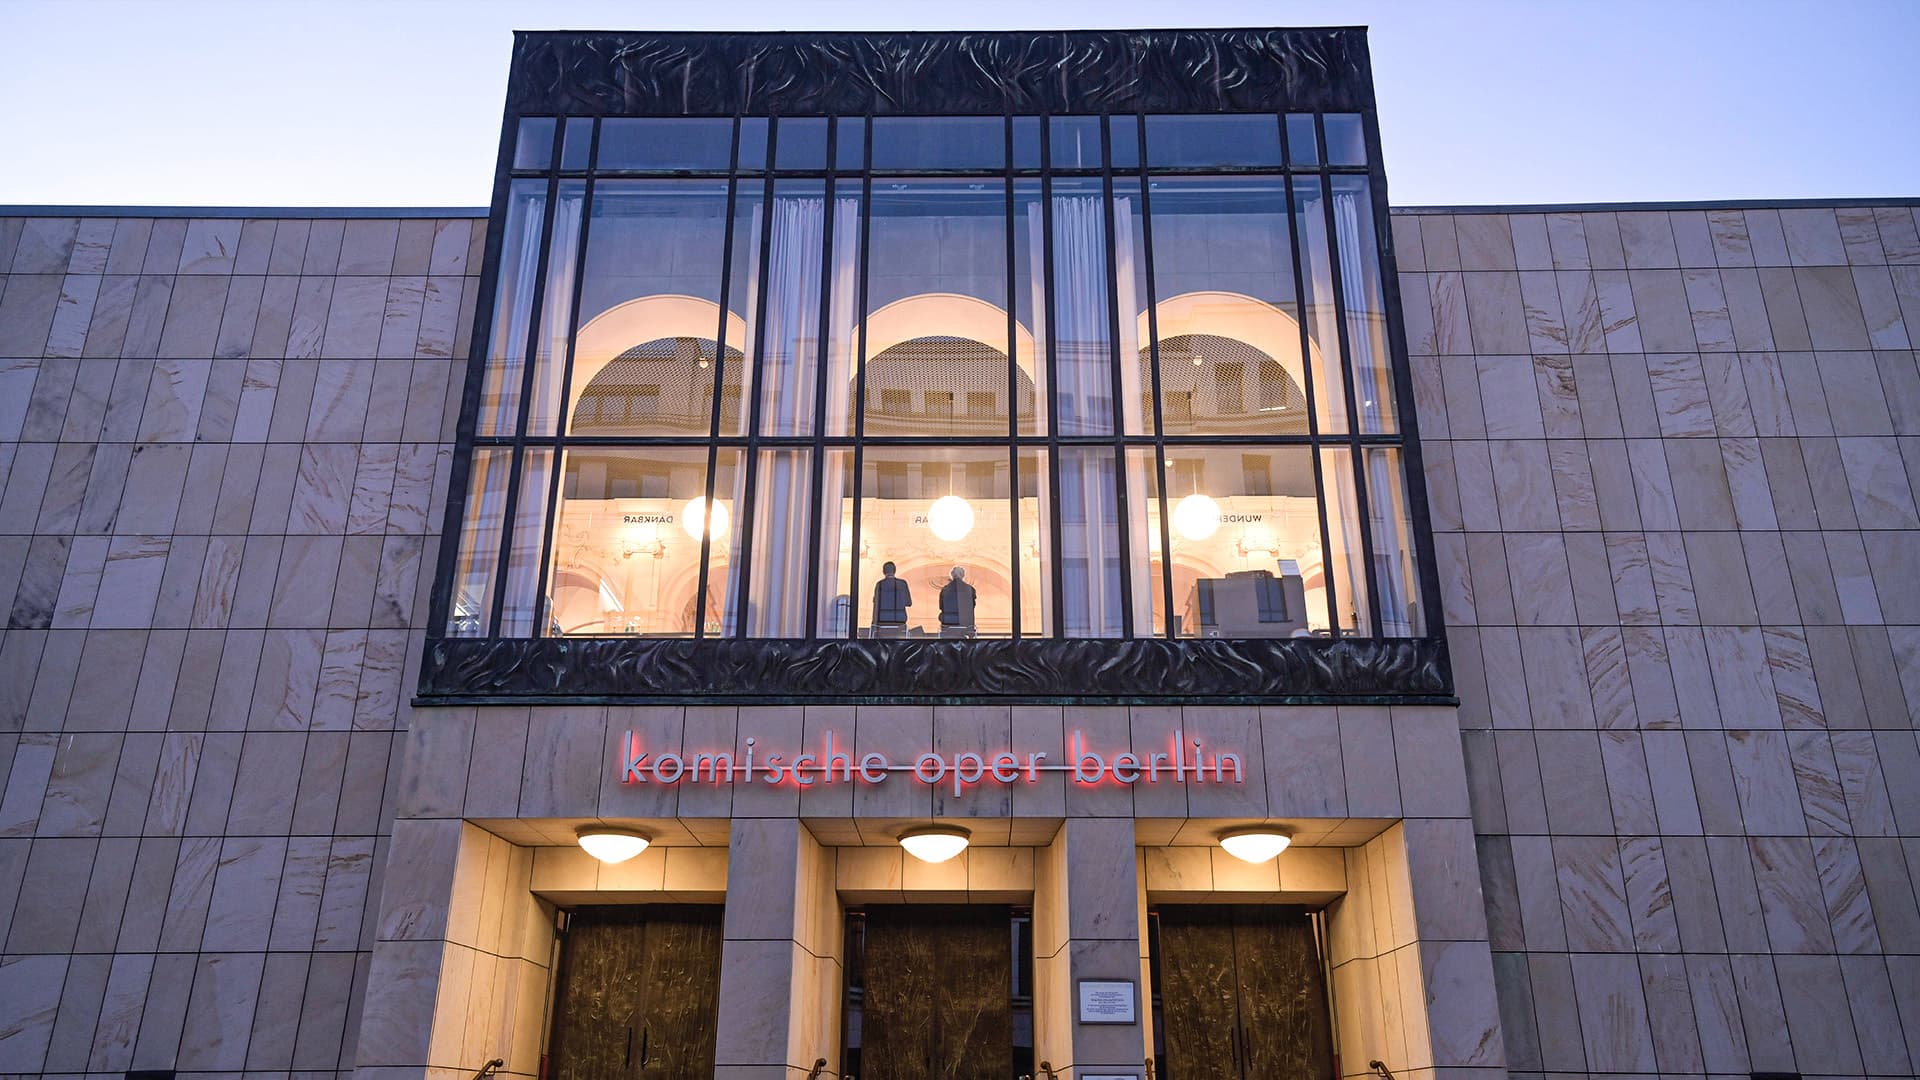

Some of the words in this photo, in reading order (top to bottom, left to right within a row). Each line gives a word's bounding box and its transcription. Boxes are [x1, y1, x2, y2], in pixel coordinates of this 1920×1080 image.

[622, 730, 889, 784] komische
[914, 752, 1047, 798] oper
[1074, 729, 1243, 784] berlin
